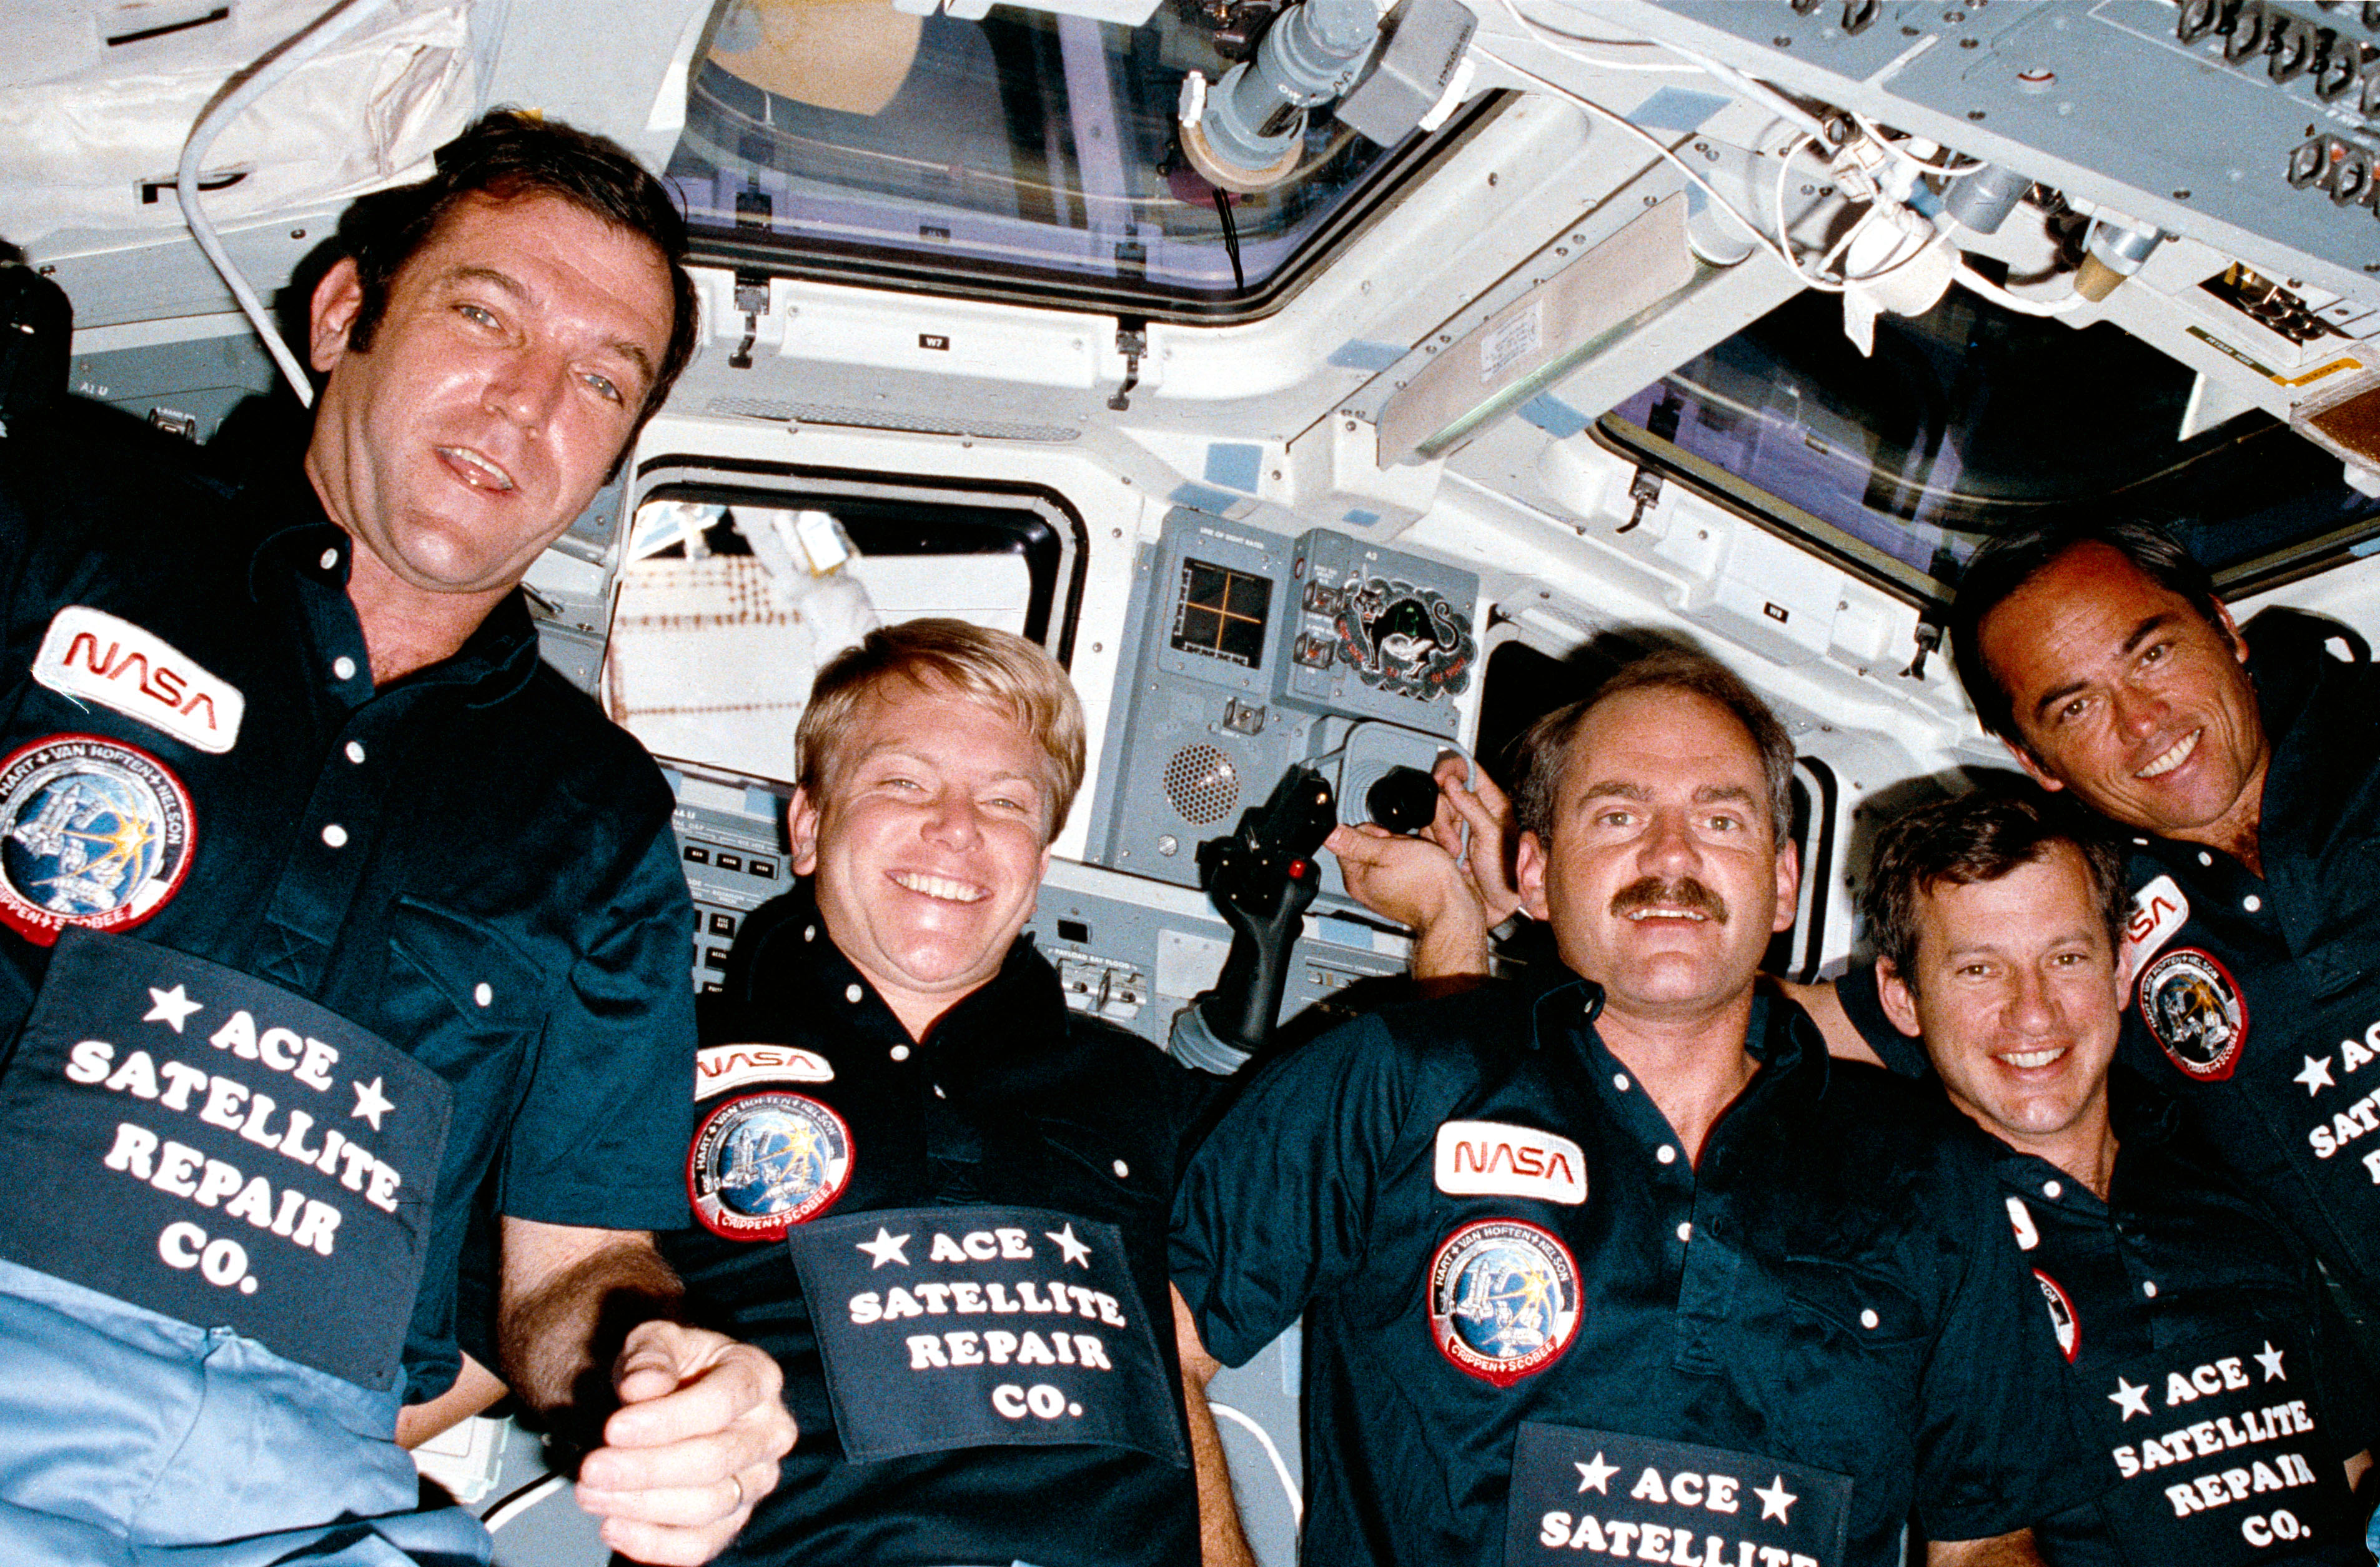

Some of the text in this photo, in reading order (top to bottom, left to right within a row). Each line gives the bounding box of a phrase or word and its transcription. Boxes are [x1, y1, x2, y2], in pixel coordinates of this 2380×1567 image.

[926, 337, 942, 347] W7
[63, 632, 217, 731] NASA
[0, 745, 182, 844] HART VAN HOFTEN NELSON
[2128, 896, 2177, 944] SA
[1054, 948, 1088, 961] PAYLOAD
[1105, 958, 1130, 968] FLOOD
[211, 1010, 339, 1091] ACE
[2219, 1029, 2239, 1065] SCOBEE
[64, 1040, 401, 1213] SATELLITE
[696, 1096, 838, 1170] HART VAN HOFTEN NELSON
[1454, 1141, 1574, 1184] NASA
[104, 1123, 342, 1256] REPAIR
[721, 1186, 833, 1230] CRIPPEN SCOBEE
[158, 1221, 258, 1294] CO.
[930, 1228, 1033, 1262] ACE
[1435, 1228, 1570, 1286] HART VAN HOFTEN NELSON
[850, 1281, 1126, 1328] SATELLITE
[906, 1331, 1111, 1370] REPAIR
[1450, 1340, 1554, 1372] CRIPPEN SCOBEE
[992, 1384, 1082, 1418] CO.
[2166, 1356, 2249, 1406] ACE
[2112, 1400, 2314, 1479] SATELLITE
[1630, 1467, 1739, 1513] ACE
[2164, 1453, 2316, 1518] REPAIR
[2241, 1509, 2311, 1547] CO.
